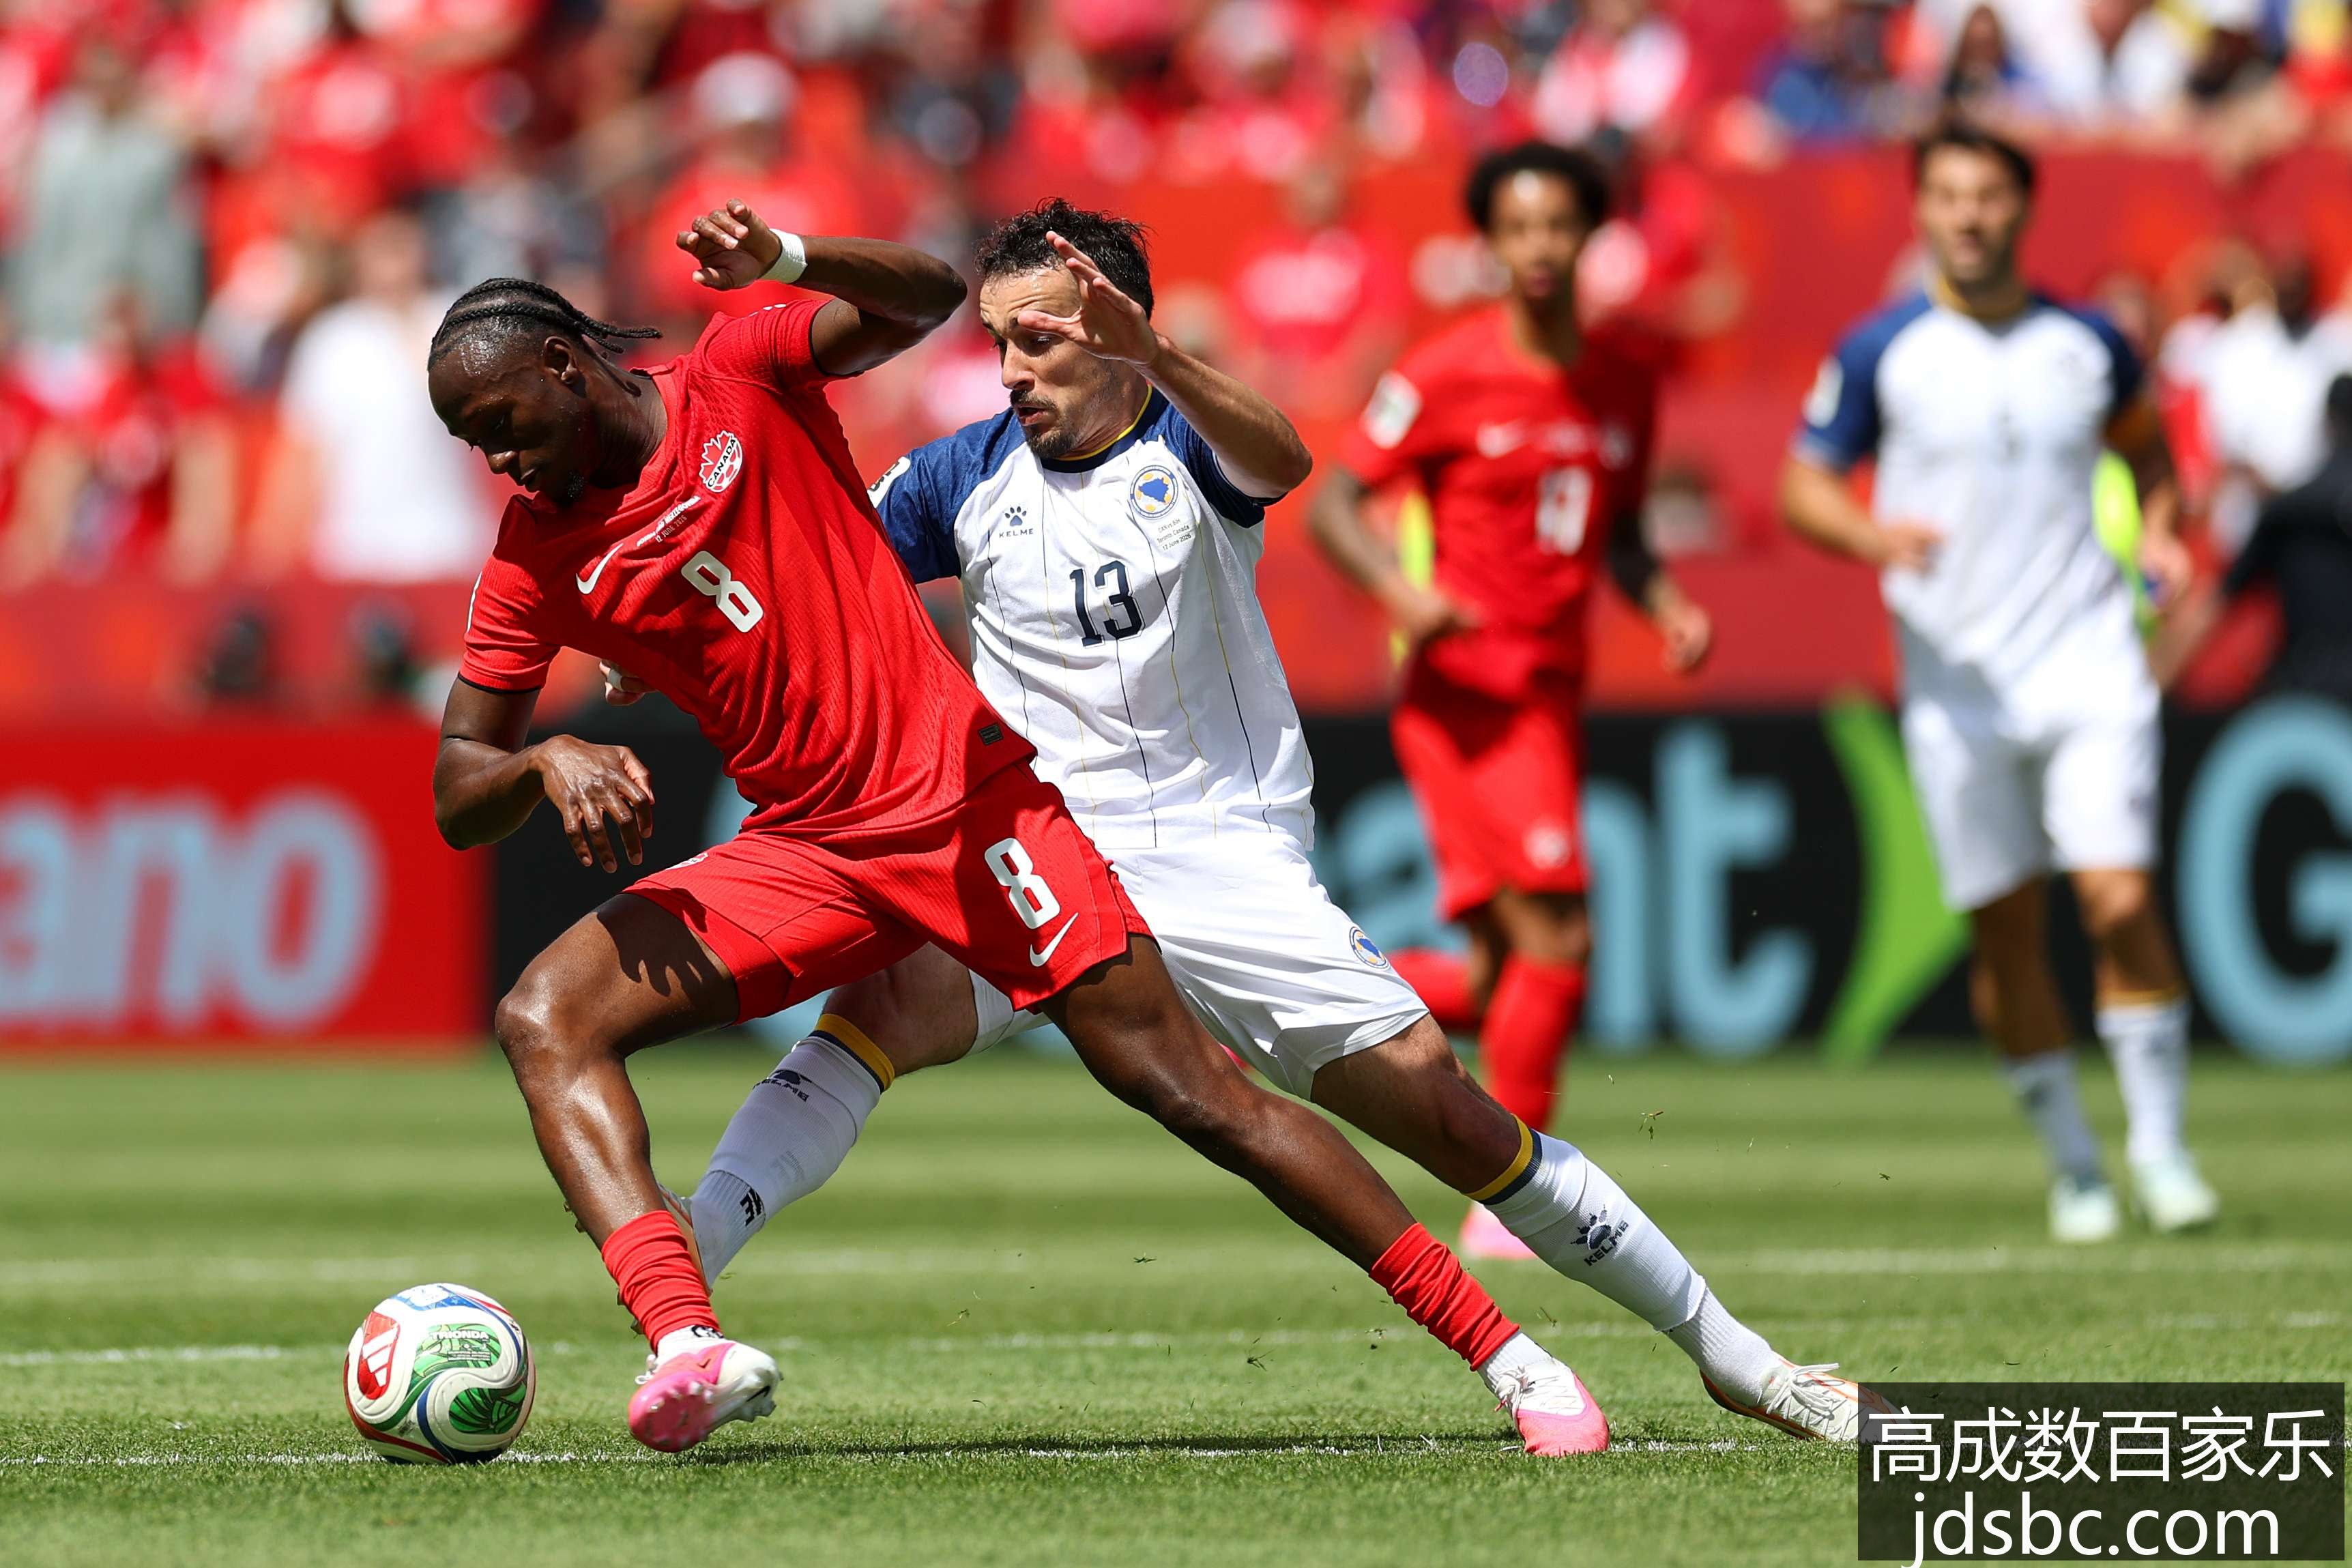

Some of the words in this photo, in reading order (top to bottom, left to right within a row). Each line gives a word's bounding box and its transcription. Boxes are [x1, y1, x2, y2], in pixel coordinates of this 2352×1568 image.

[708, 439, 736, 487] CANADA
[660, 524, 676, 538] JUNE
[999, 528, 1034, 538] KELME
[1179, 532, 1192, 543] 2026
[681, 550, 764, 633] 8
[1069, 560, 1145, 648] 13
[984, 837, 1061, 929] 8
[1584, 1220, 1629, 1267] KELME
[431, 1330, 490, 1340] TRIONDA
